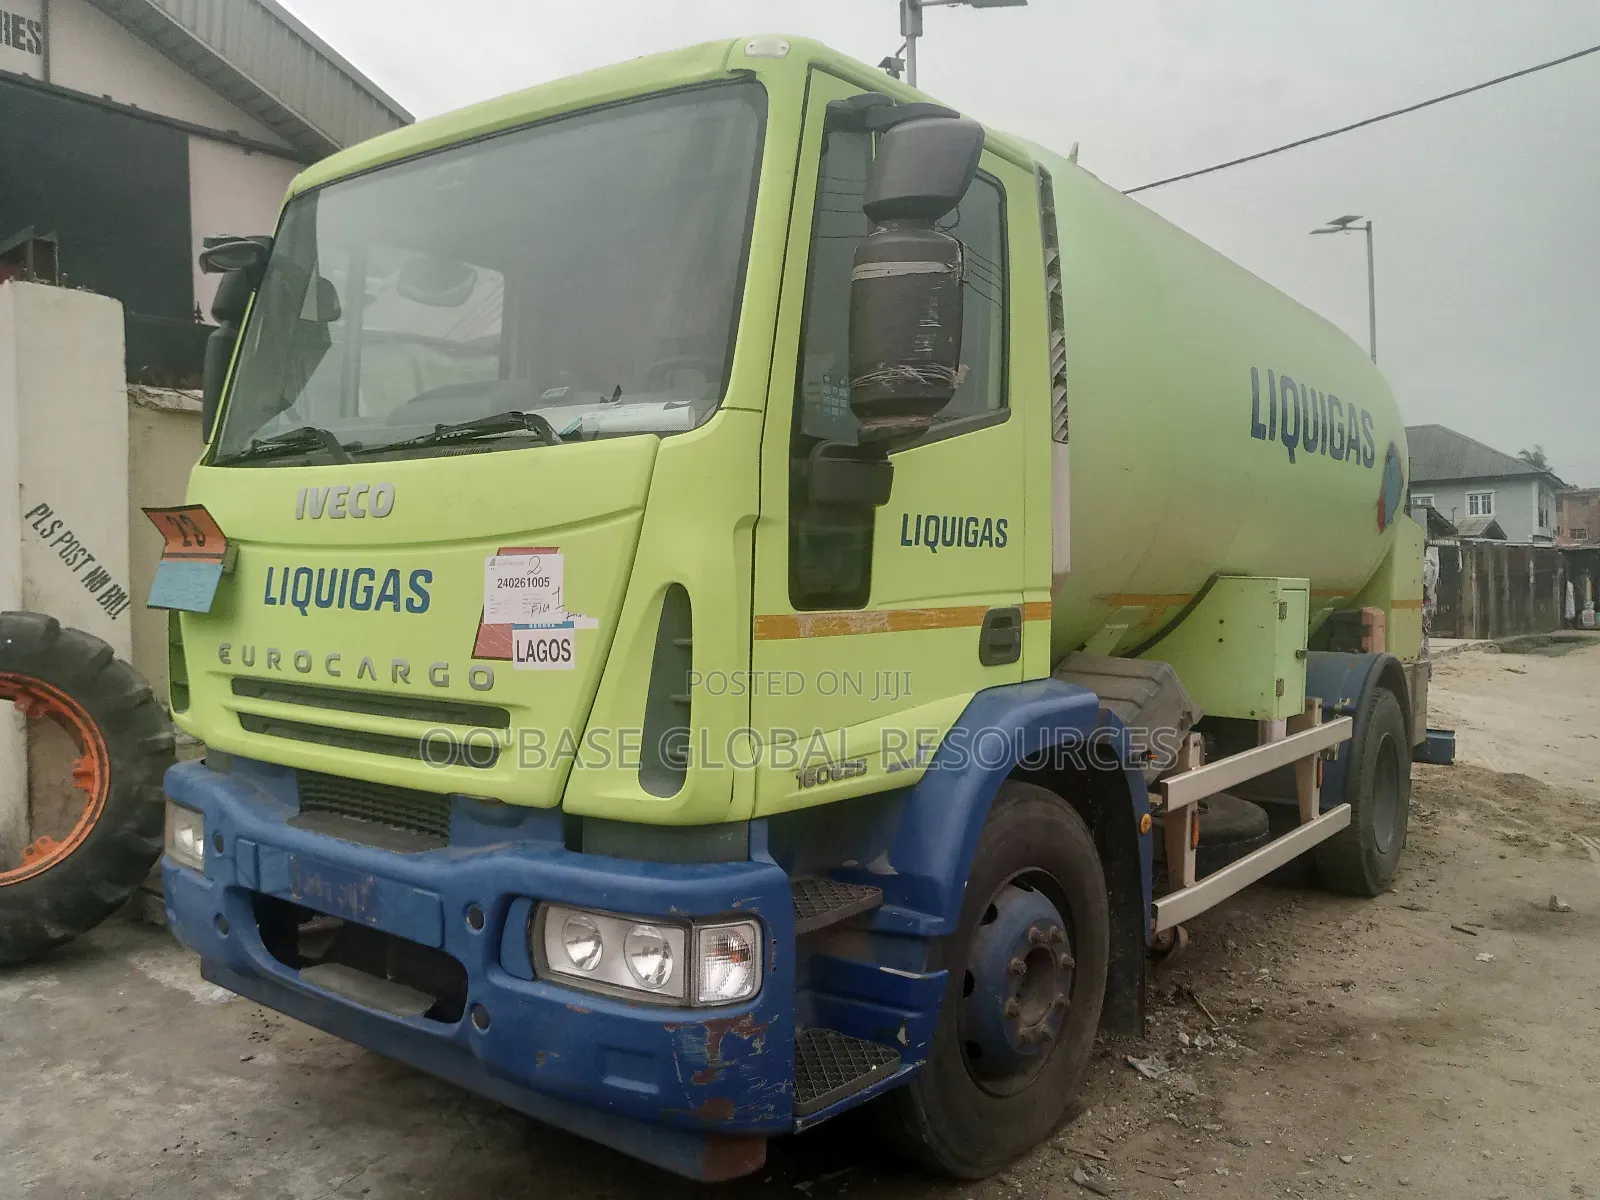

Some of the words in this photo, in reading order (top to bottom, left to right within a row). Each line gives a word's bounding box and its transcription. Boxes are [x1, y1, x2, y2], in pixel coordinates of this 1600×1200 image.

[1250, 366, 1376, 469] LIQUIGAS
[295, 482, 395, 520] IVECO
[24, 502, 64, 539] PLS
[49, 530, 96, 573] POST
[900, 513, 1008, 554] LIQUIGAS
[497, 577, 550, 588] 240261005
[526, 555, 542, 575] 2
[264, 566, 433, 616] LIQUIGAS
[218, 642, 495, 691] EUROCARGO
[516, 638, 572, 662] LAGOS
